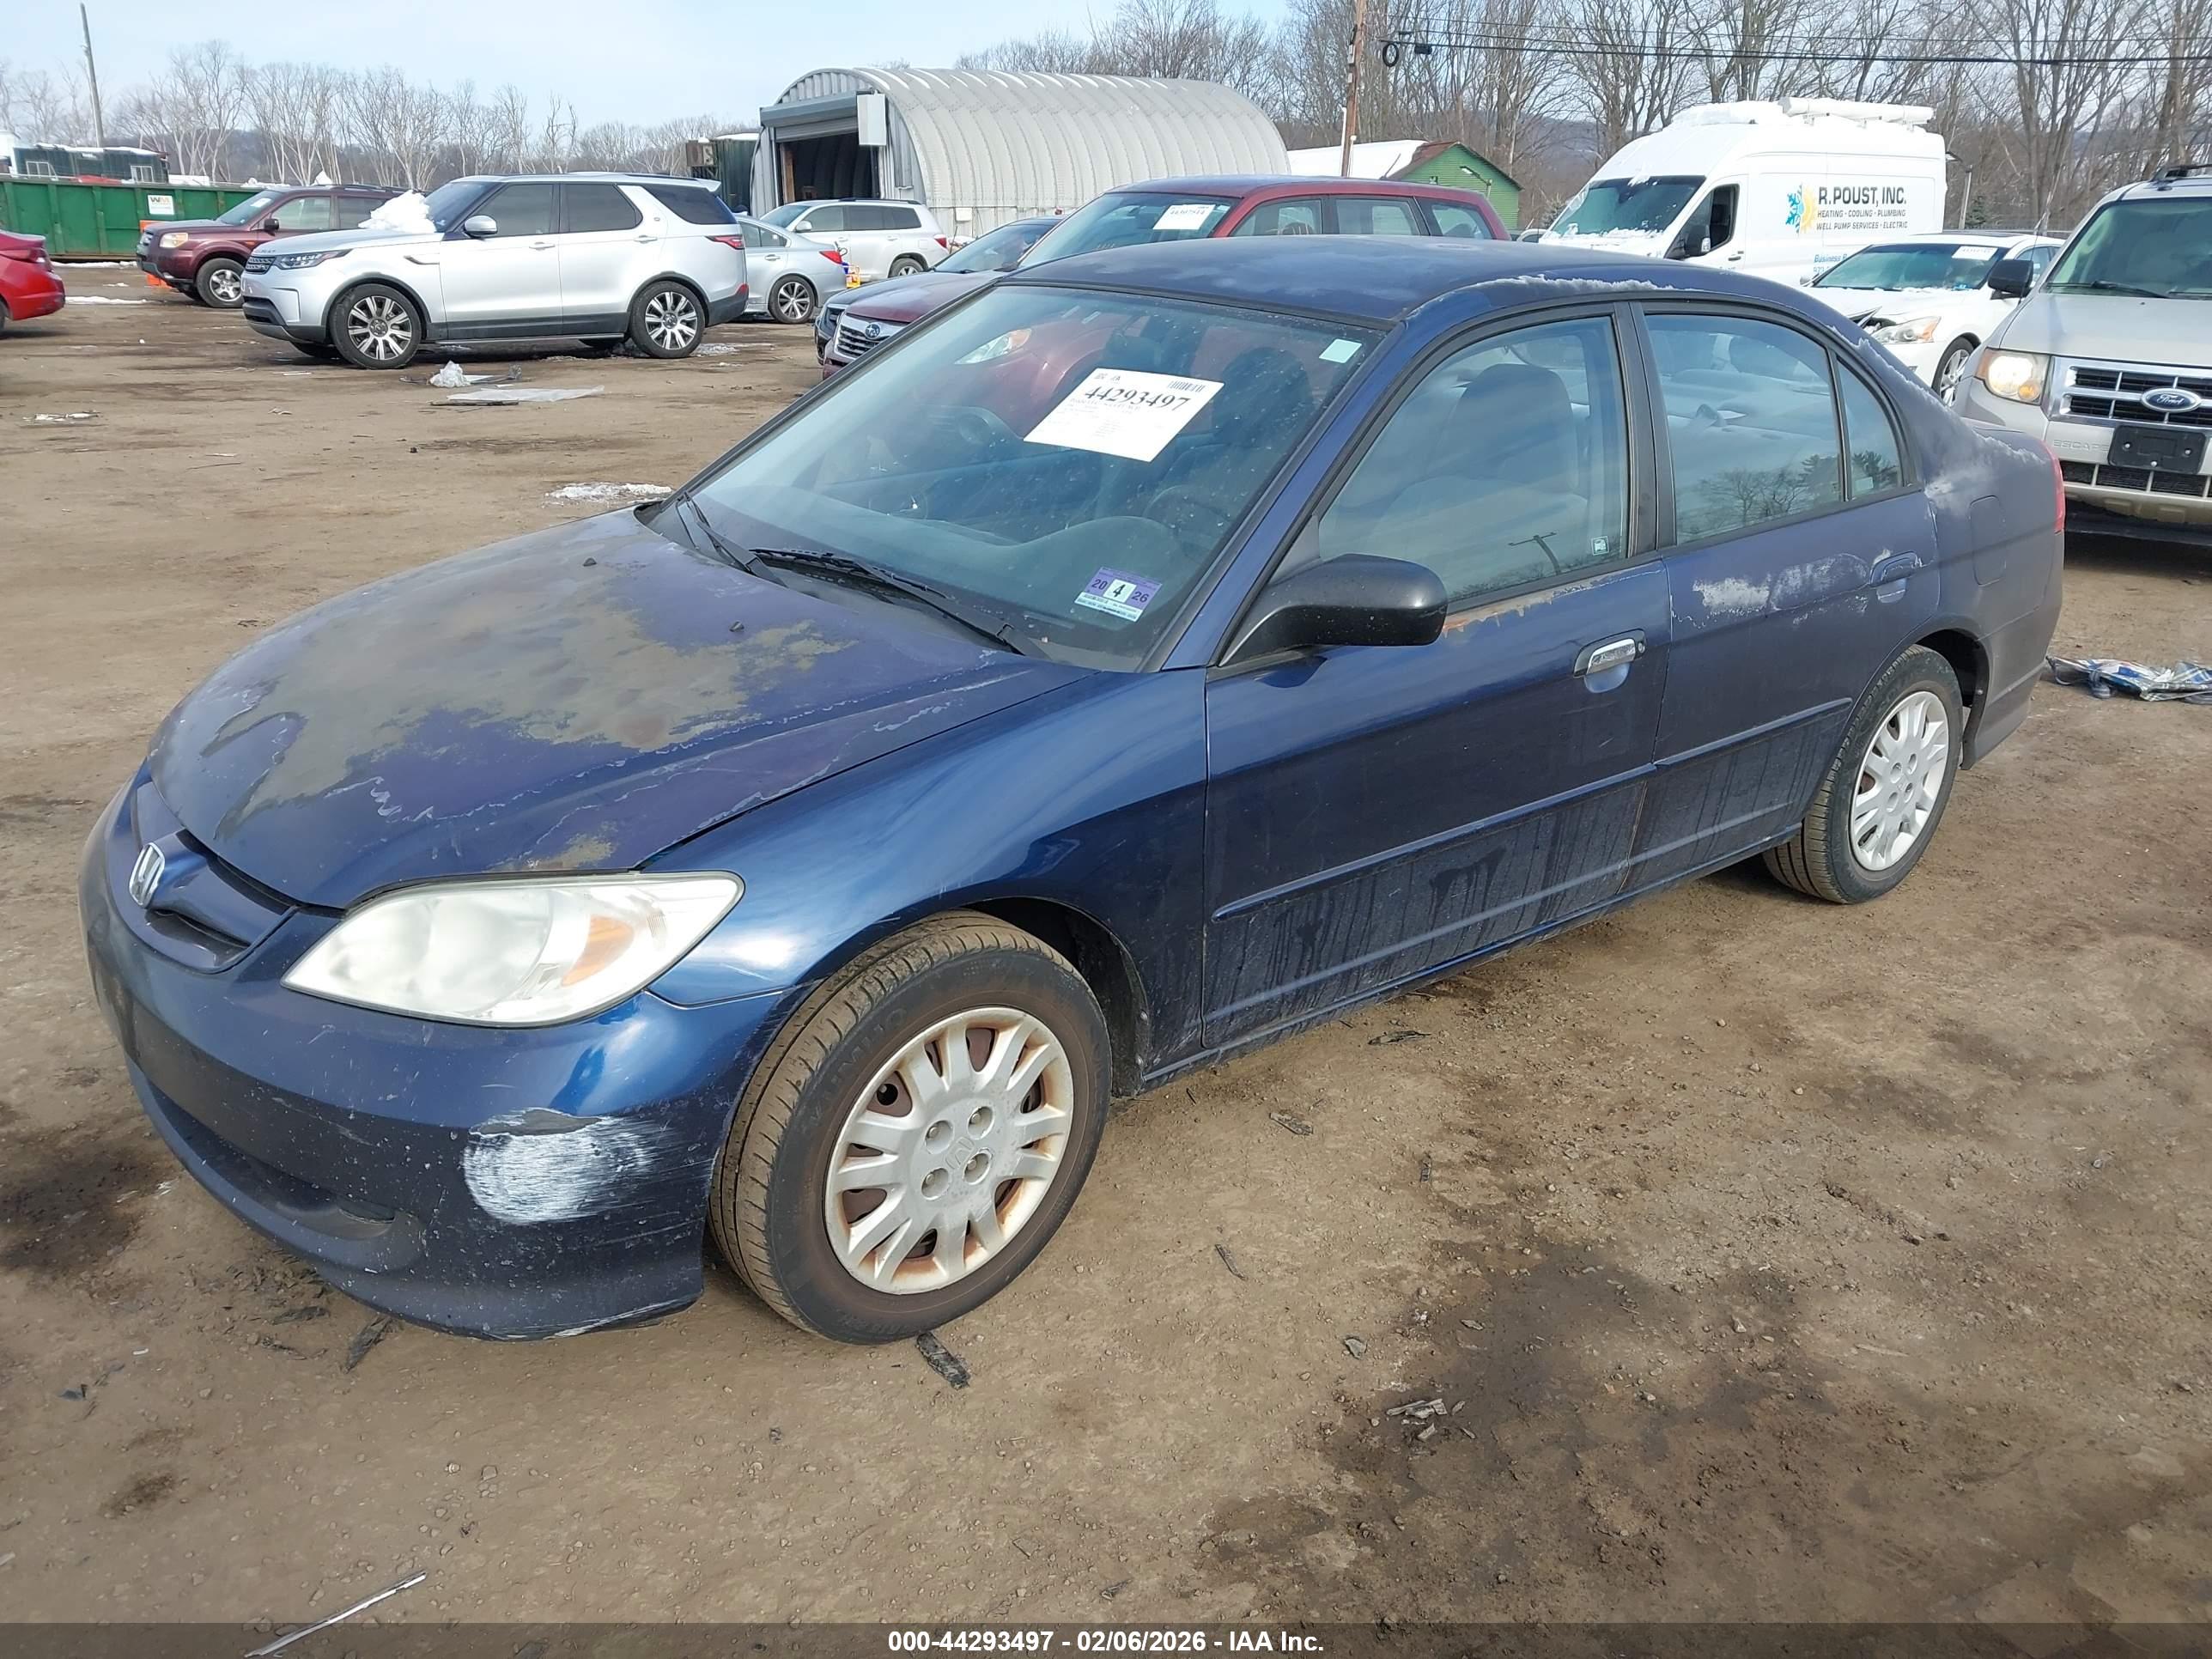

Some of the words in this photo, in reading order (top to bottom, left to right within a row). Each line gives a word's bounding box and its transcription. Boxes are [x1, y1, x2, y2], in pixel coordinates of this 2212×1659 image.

[1882, 186, 1907, 205] INC.
[1817, 210, 1844, 218] HEATING
[1878, 209, 1906, 217] PLUMBING
[1833, 222, 1851, 230] PUMP
[1883, 221, 1908, 229] ELECTRIC
[1814, 253, 1841, 263] Business
[1085, 386, 1191, 411] 44293497
[1091, 579, 1108, 590] 20
[1113, 584, 1126, 598] 4
[1132, 591, 1149, 603] 26
